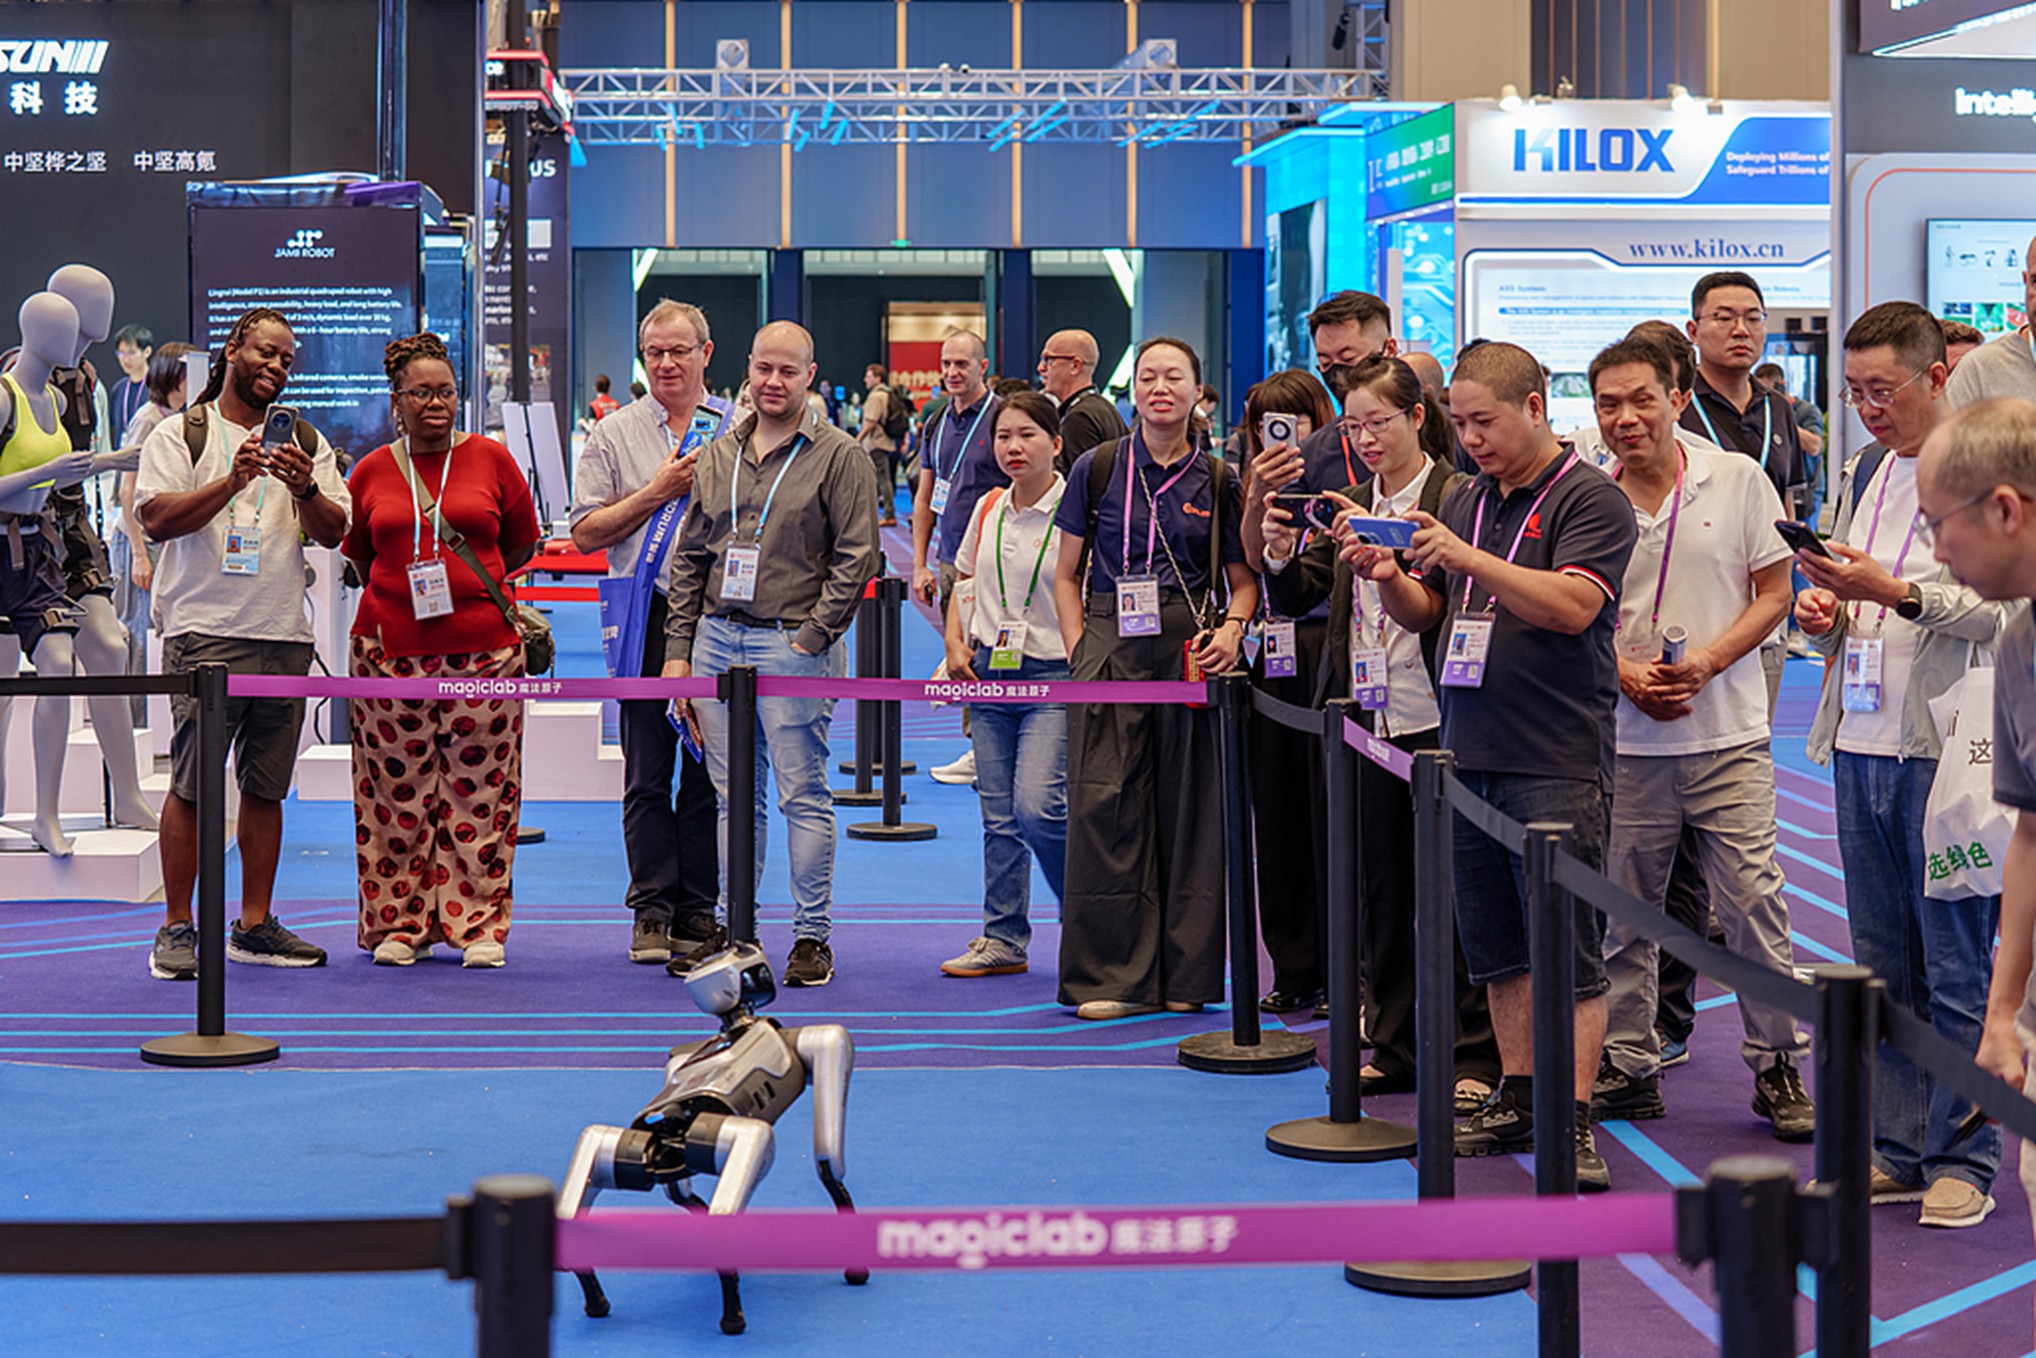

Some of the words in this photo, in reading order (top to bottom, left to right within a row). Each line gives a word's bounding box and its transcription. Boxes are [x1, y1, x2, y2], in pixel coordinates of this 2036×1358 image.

[10, 81, 98, 115] 科技
[1513, 128, 1676, 172] KILOX
[1726, 151, 1777, 164] Deploying
[1778, 151, 1817, 162] Millions
[1818, 152, 1830, 162] of
[1726, 164, 1776, 177] Safeguard
[1778, 164, 1816, 175] Trillions
[1817, 165, 1829, 175] of
[302, 248, 335, 258] ROBOT
[1629, 238, 1784, 259] www.kilox.cn
[438, 679, 517, 699] magiclab
[924, 682, 1004, 701] magiclab
[876, 1210, 1110, 1270] magiclab
